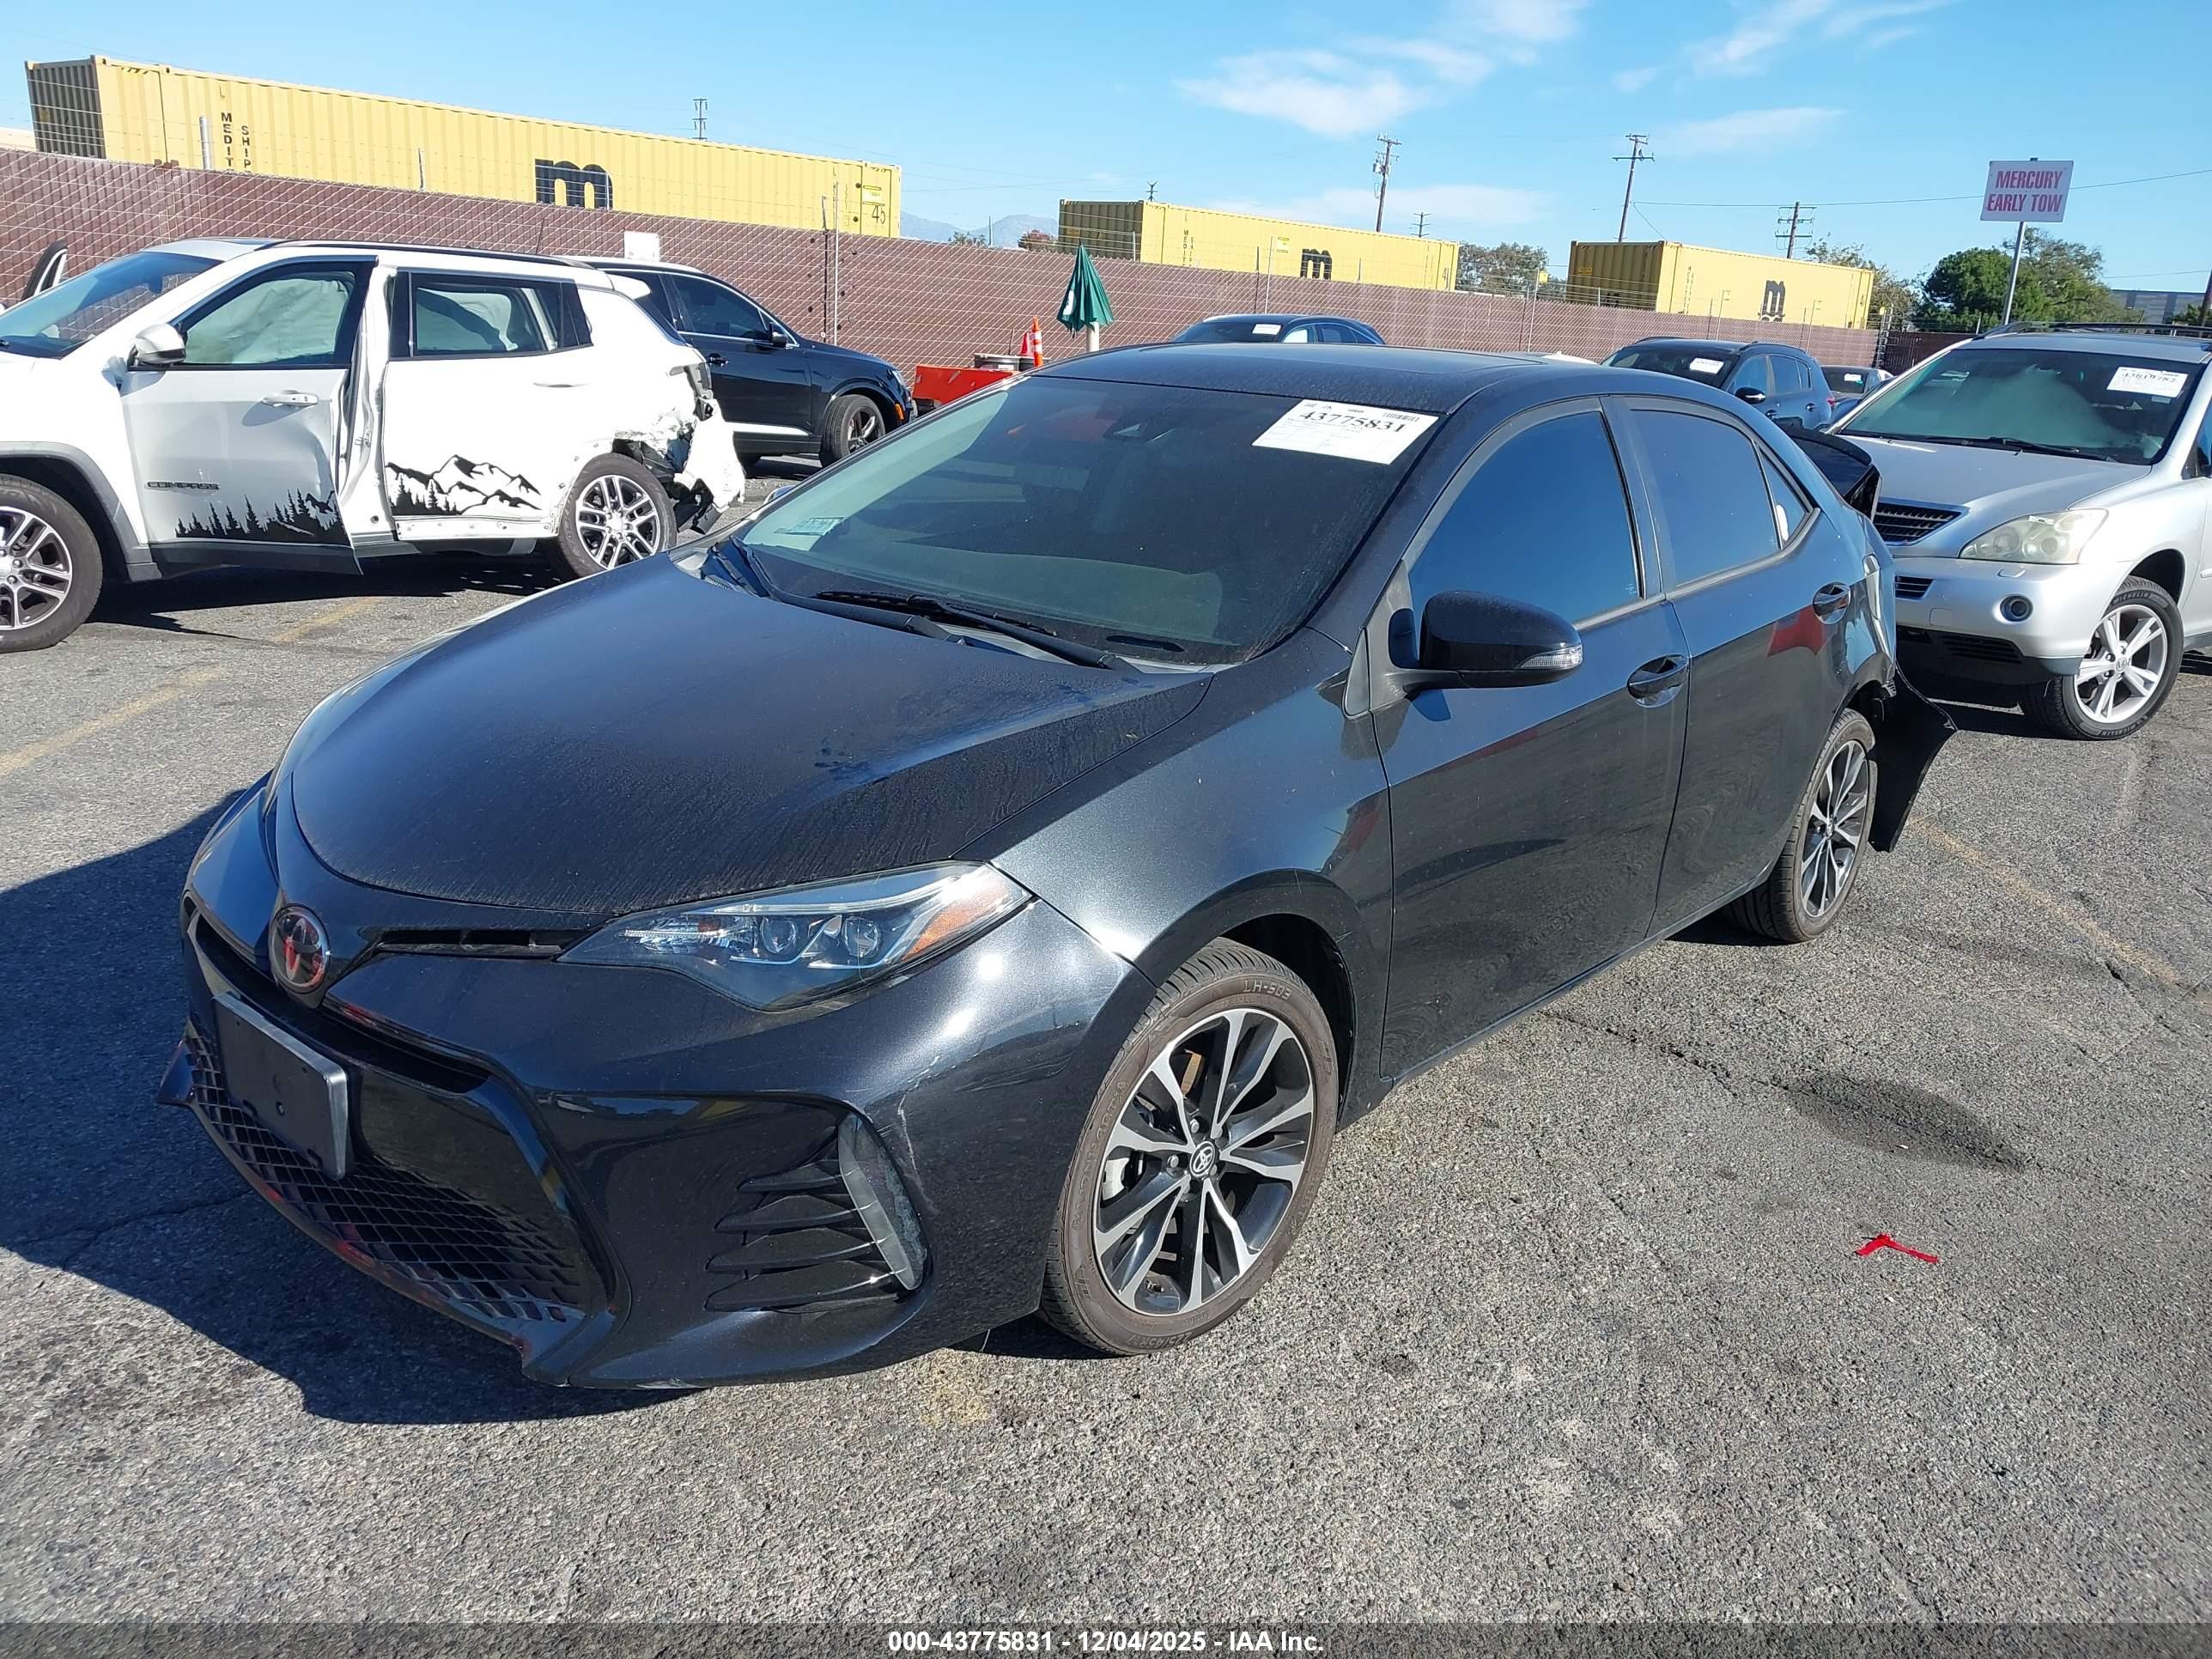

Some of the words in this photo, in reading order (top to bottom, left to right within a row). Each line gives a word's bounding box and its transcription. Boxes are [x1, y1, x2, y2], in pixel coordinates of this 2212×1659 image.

[221, 112, 234, 171] MEDIT
[241, 125, 252, 172] SHIP
[1996, 170, 2063, 189] MERCURY
[1987, 193, 2027, 212] EARLY
[2031, 193, 2063, 212] TOW
[872, 205, 886, 225] 45
[1299, 410, 1407, 432] 43775831
[1243, 979, 1291, 1000] LH-503
